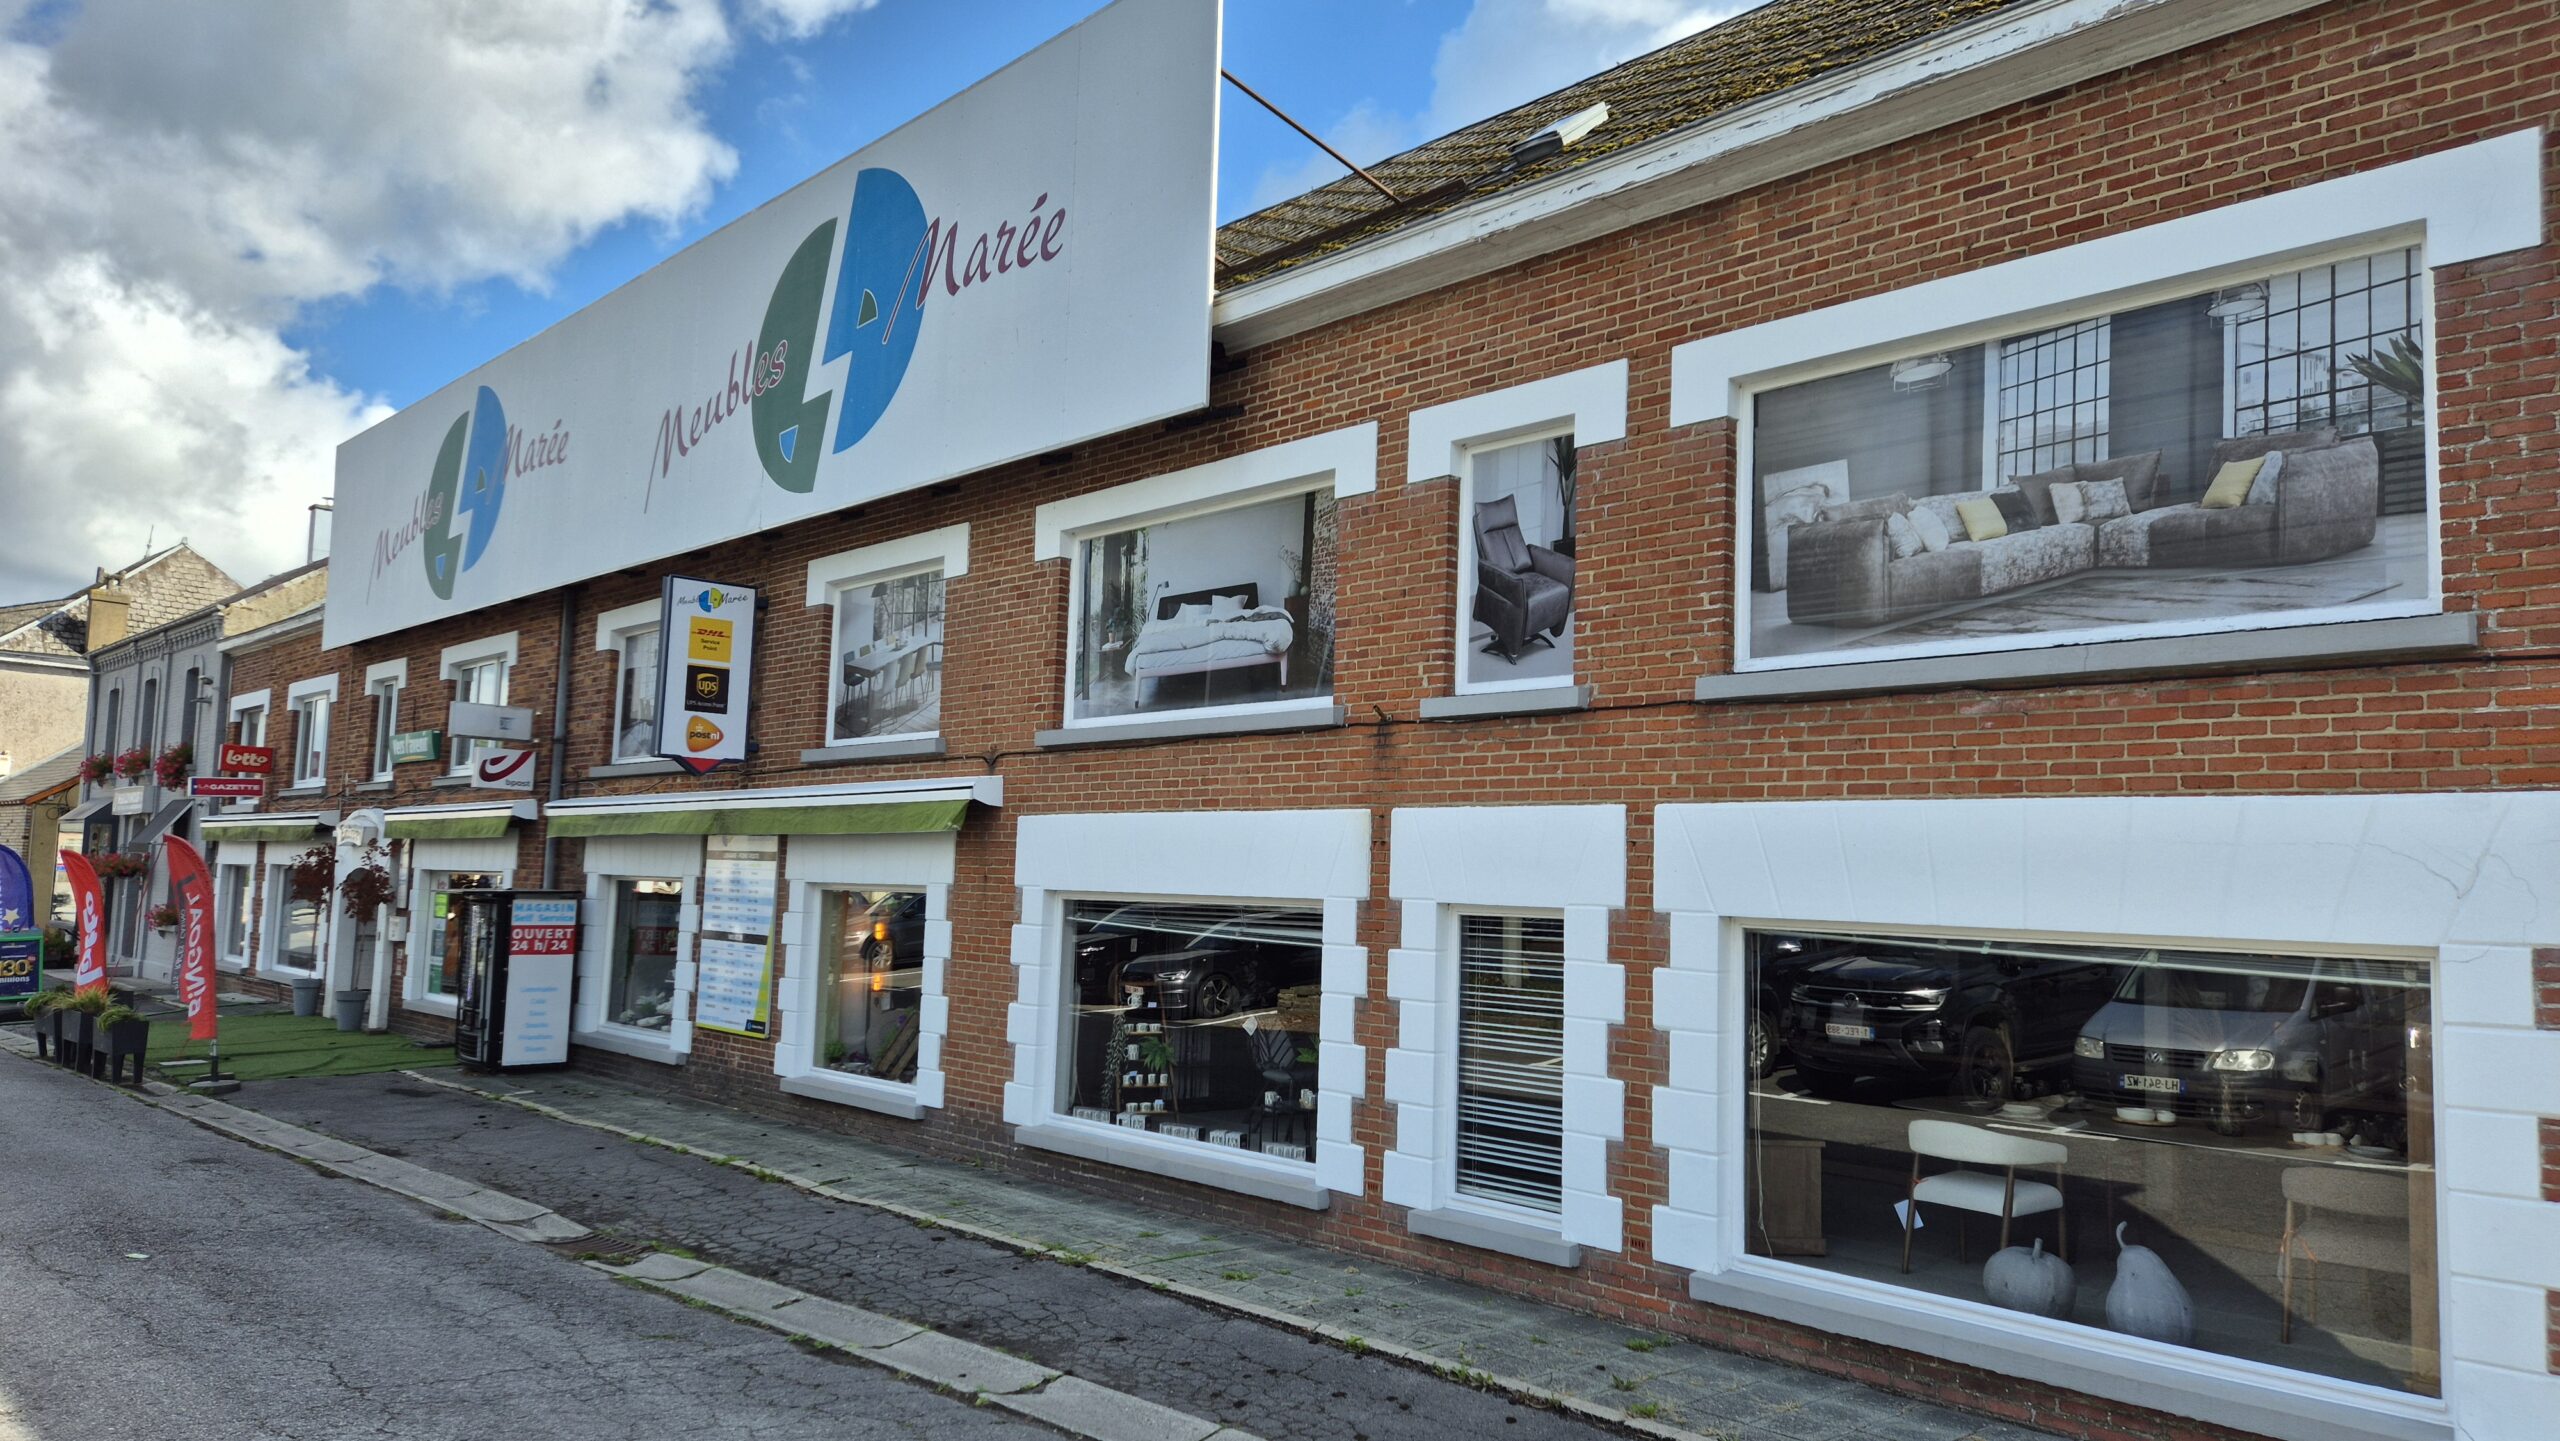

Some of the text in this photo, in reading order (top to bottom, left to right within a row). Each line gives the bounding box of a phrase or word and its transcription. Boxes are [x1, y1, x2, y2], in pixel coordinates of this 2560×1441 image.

[644, 192, 1066, 514] Meubles Marée
[366, 418, 569, 605] Meubles Marée
[696, 628, 725, 638] DHL
[698, 681, 717, 694] ups
[689, 731, 720, 740] postnl
[226, 750, 268, 767] Lotto
[505, 780, 530, 788] bpost
[514, 903, 574, 912] MAGASIN
[512, 928, 574, 939] OUVERT
[511, 940, 528, 950] 24
